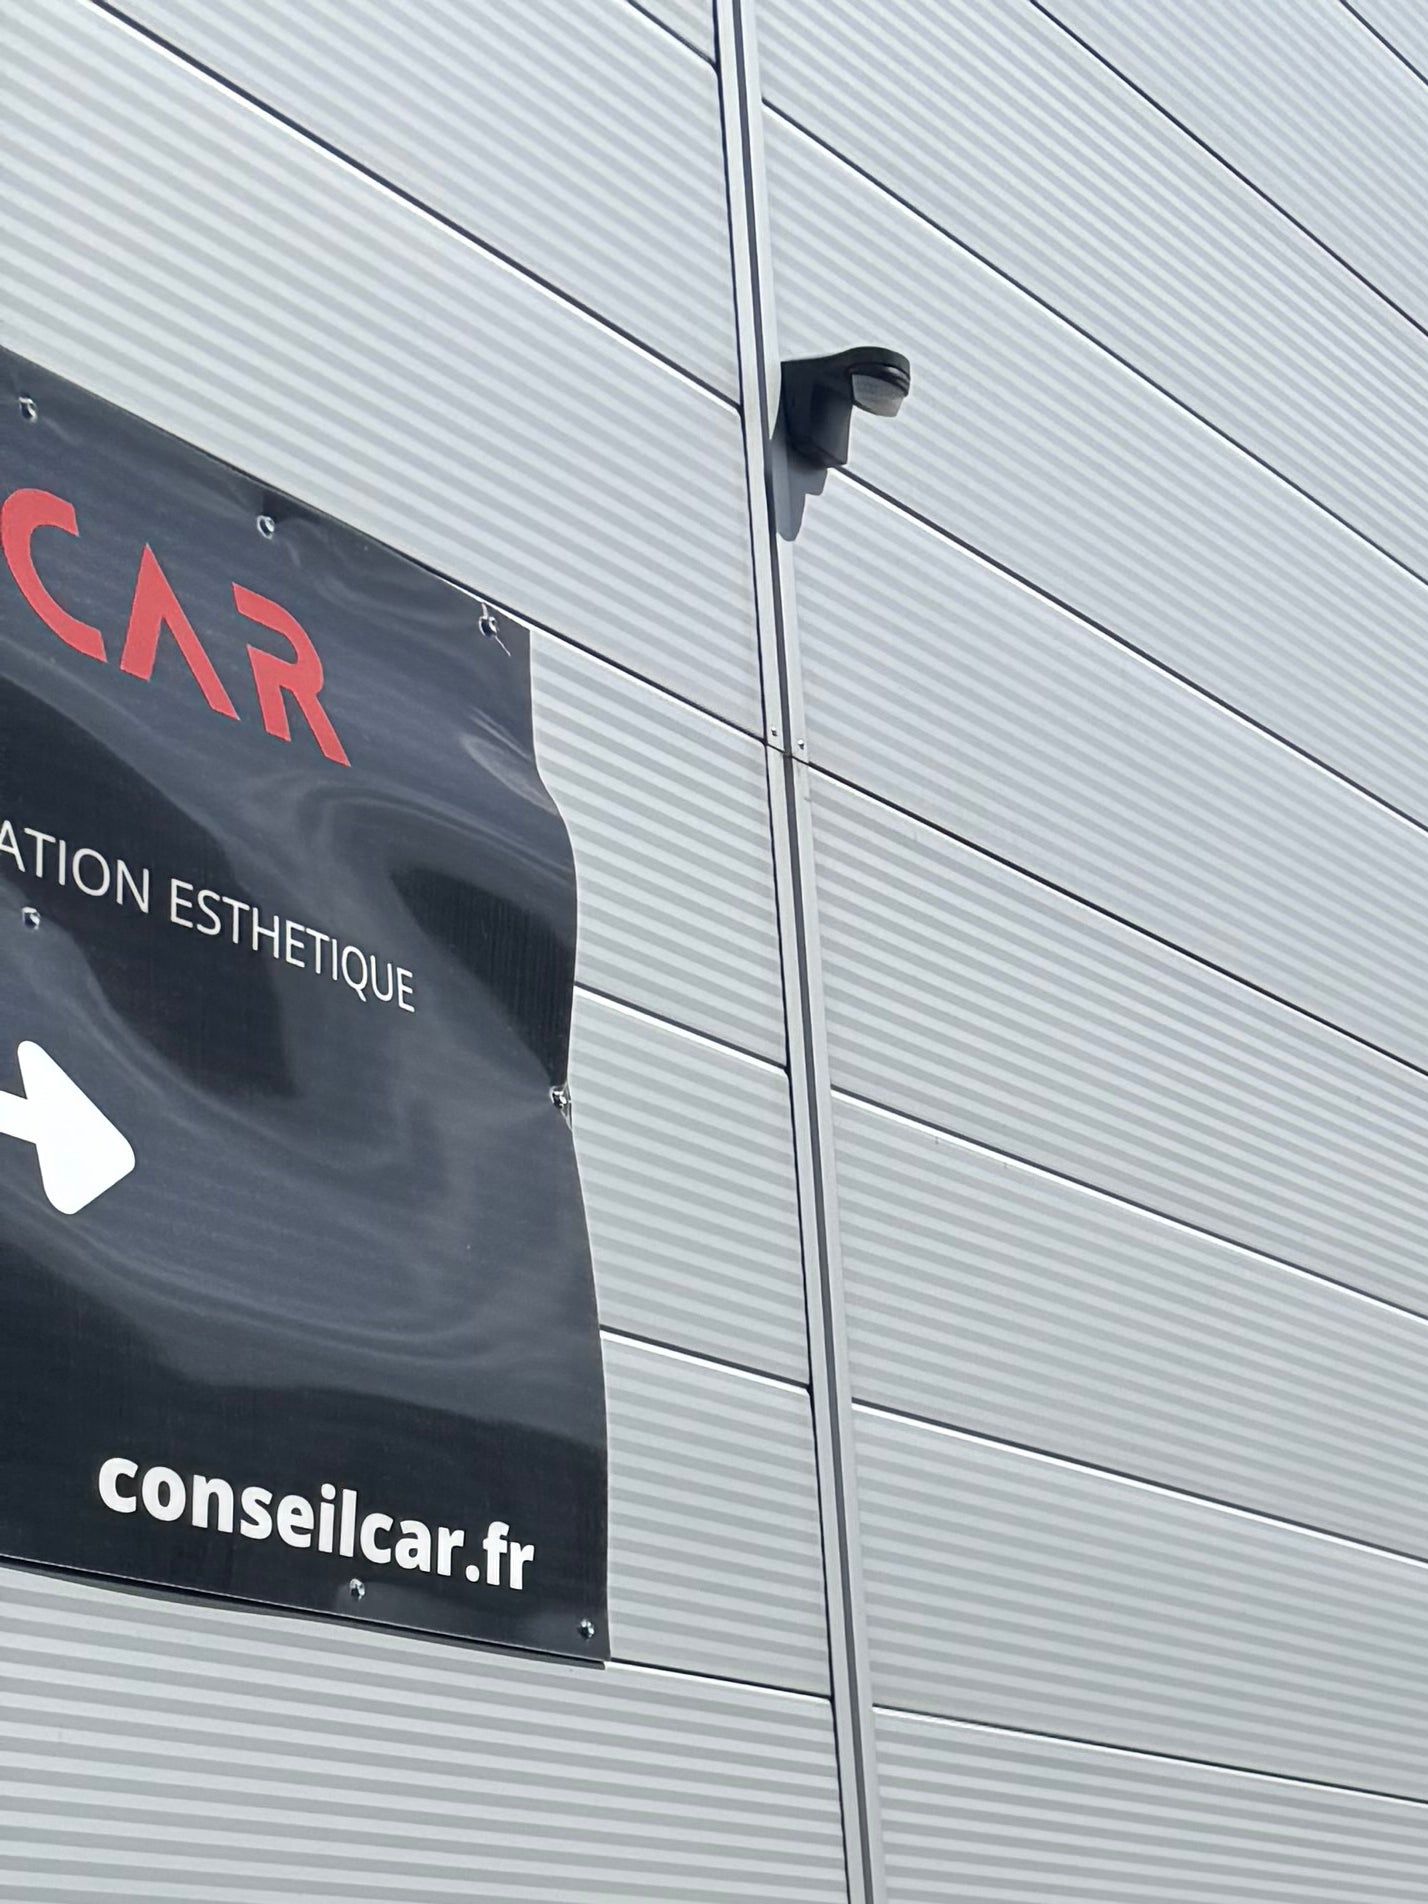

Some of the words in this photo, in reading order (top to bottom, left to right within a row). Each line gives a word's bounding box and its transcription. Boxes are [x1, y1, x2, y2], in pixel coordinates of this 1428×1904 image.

[2, 487, 350, 767] CAR
[170, 877, 416, 1014] ESTHETIQUE
[98, 1456, 535, 1591] conseilcar.fr
